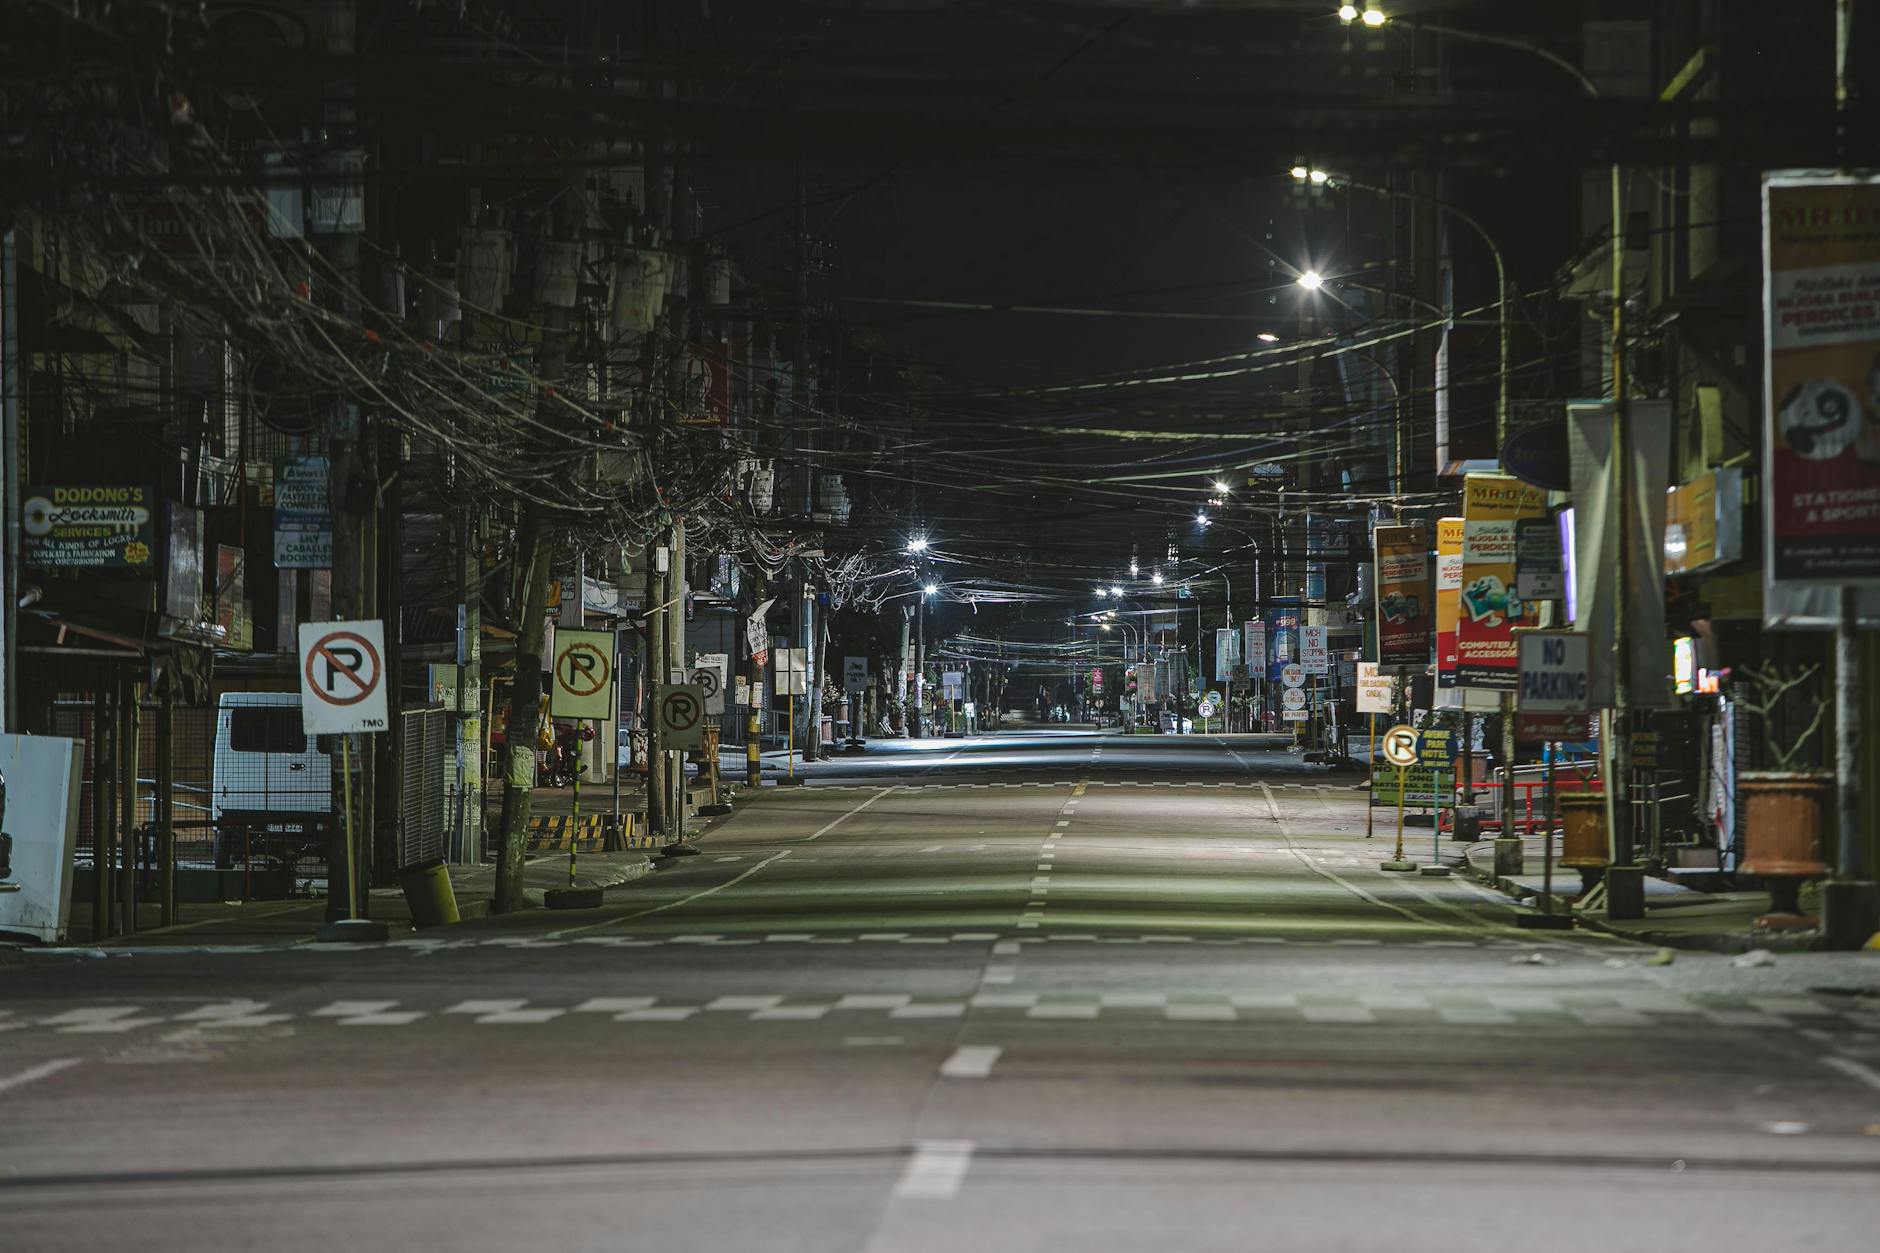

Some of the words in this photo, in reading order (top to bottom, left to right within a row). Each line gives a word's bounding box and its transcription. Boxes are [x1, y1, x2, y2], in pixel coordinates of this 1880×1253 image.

[288, 484, 315, 492] ENJOY
[54, 487, 143, 502] DODONG'S
[49, 507, 136, 523] Locksmith
[53, 527, 112, 537] SERVICES
[41, 537, 55, 548] ALL
[59, 541, 85, 550] KINDS
[88, 540, 99, 548] OF
[300, 534, 319, 544] LILY
[33, 549, 67, 558] DUPLICATE
[74, 549, 116, 558] FABRICATION
[1308, 639, 1319, 647] NO
[1460, 641, 1510, 649] COMPUTER
[1303, 648, 1326, 656] STOPPING
[1543, 638, 1566, 665] NO
[1524, 671, 1585, 699] PARKING
[362, 719, 384, 728] TMO
[1423, 731, 1451, 739] AVENUE
[1426, 740, 1448, 749] PARK
[1421, 750, 1450, 759] HOTEL
[1374, 765, 1392, 773] NO
